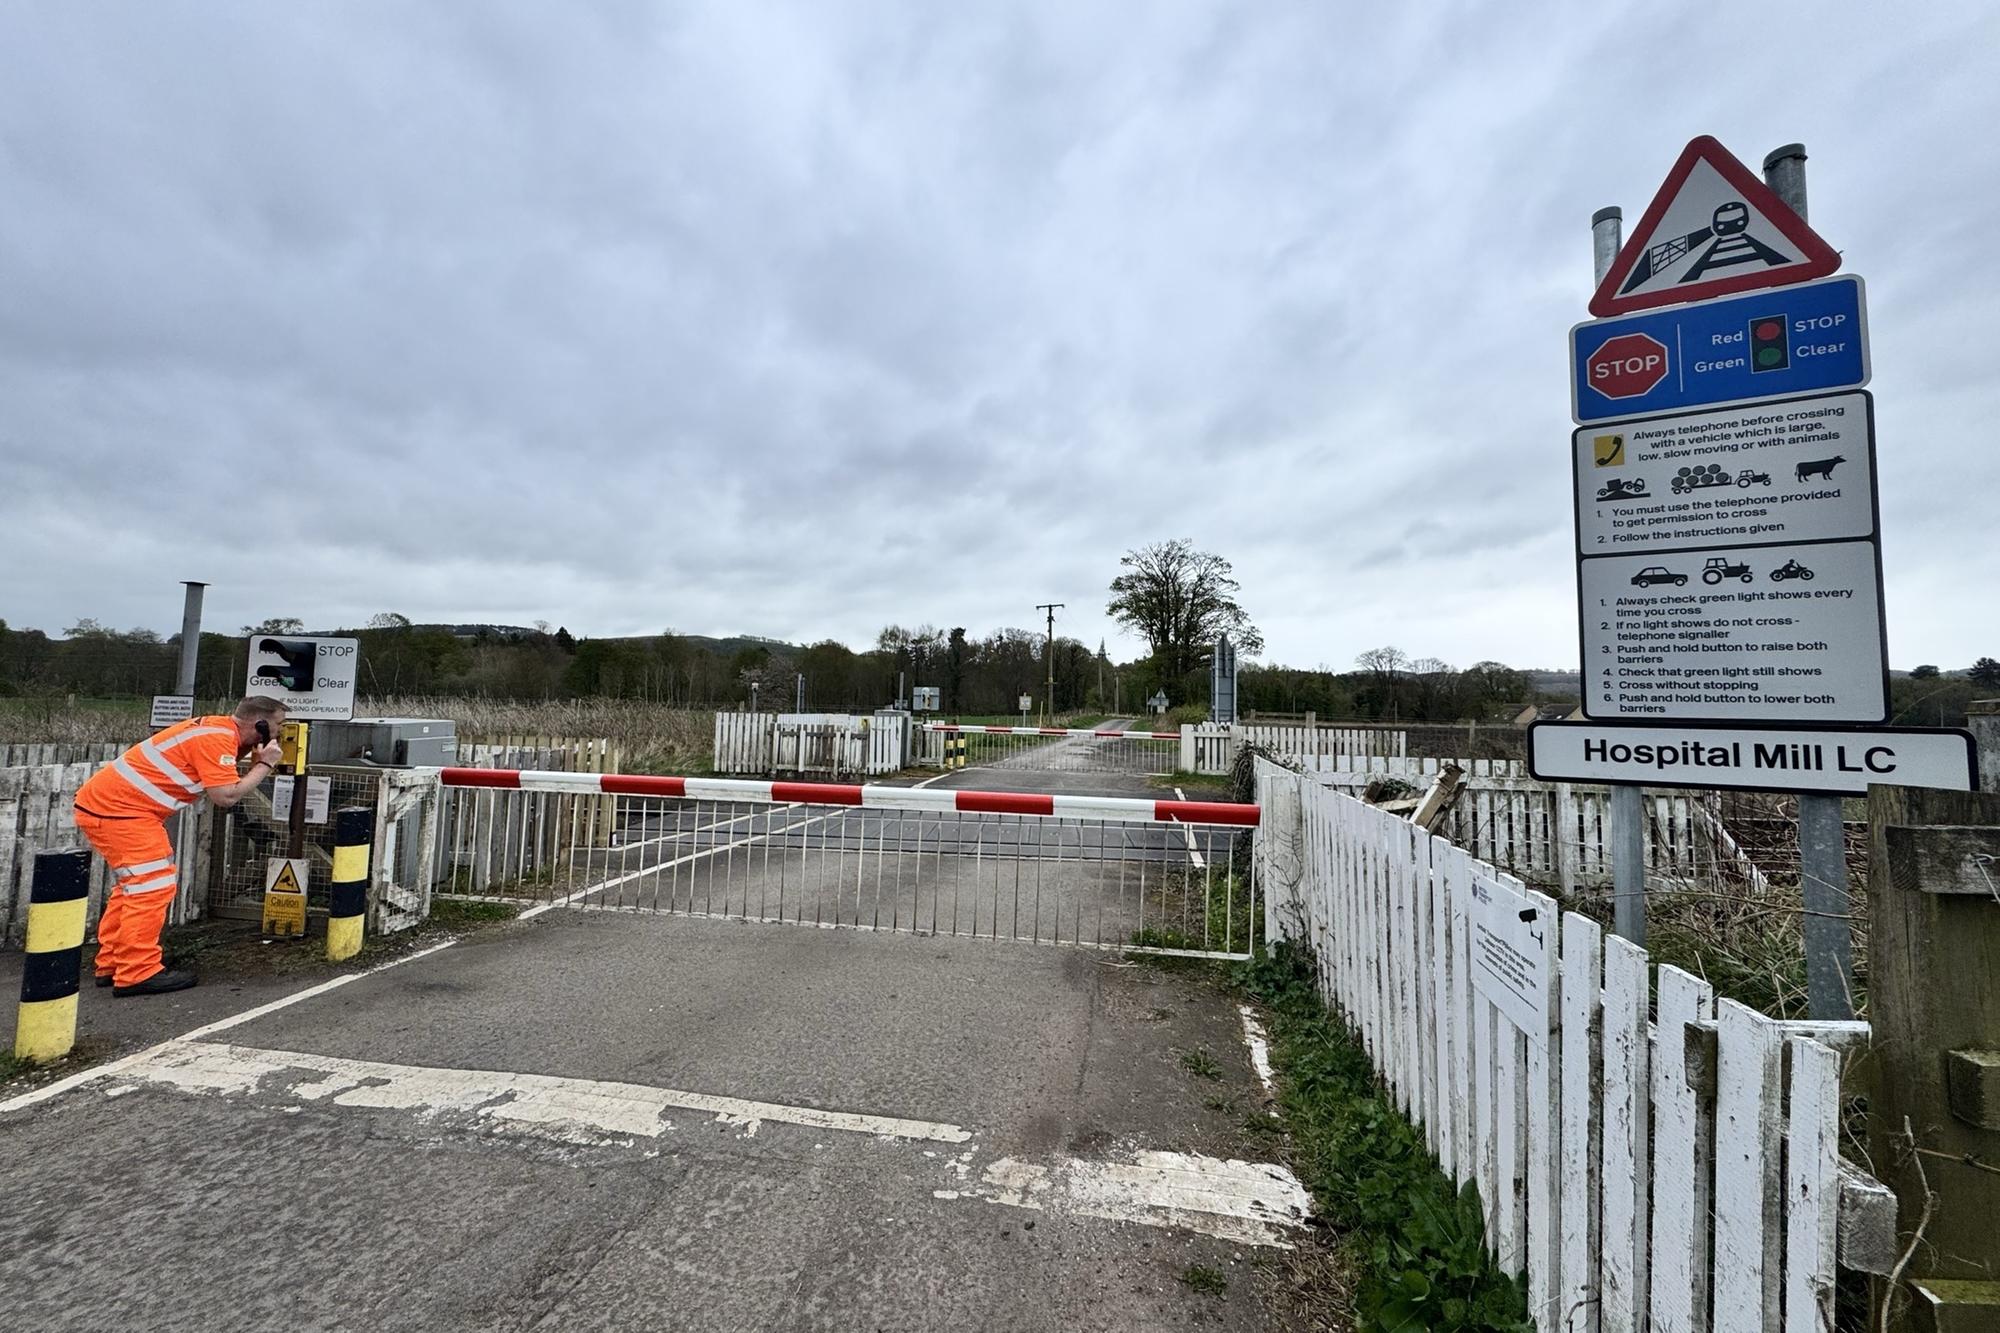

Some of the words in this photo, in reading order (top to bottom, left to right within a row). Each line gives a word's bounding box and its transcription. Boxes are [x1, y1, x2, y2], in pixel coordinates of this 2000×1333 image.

[1712, 330, 1743, 346] Red
[1794, 313, 1846, 332] STOP
[1694, 357, 1744, 373] Green
[1796, 341, 1846, 358] Clear
[1595, 354, 1660, 379] STOP
[1633, 428, 1676, 441] Always
[1678, 420, 1739, 435] telephone
[1741, 414, 1784, 427] before
[1786, 407, 1845, 421] crossing
[1650, 437, 1675, 449] with
[1688, 432, 1732, 445] vehicle
[1734, 427, 1772, 439] which
[1775, 425, 1786, 435] is
[1663, 449, 1691, 459] slow
[1693, 443, 1739, 456] moving
[1741, 441, 1755, 450] or
[1757, 437, 1785, 448] with
[1788, 431, 1840, 445] animals
[1612, 508, 1634, 516] You
[1636, 505, 1665, 515] must
[1668, 503, 1690, 512] use
[1692, 500, 1712, 510] the
[1714, 495, 1778, 508] telephone
[1780, 489, 1841, 504] provided
[1626, 517, 1645, 528] get
[1647, 512, 1714, 526] permission
[1716, 511, 1729, 519] to
[1731, 508, 1767, 518] cross
[1597, 535, 1607, 543] 2.
[1612, 533, 1650, 542] Follow
[1652, 531, 1671, 539] the
[1674, 525, 1747, 538] instructions
[1749, 523, 1785, 534] given
[1616, 597, 1658, 606] Always
[1660, 595, 1697, 604] check
[1699, 594, 1735, 604] green
[1738, 591, 1765, 602] light
[1768, 590, 1811, 599] shows
[1814, 589, 1853, 599] every
[1616, 609, 1641, 617] time
[1644, 609, 1665, 617] you
[1668, 607, 1702, 615] cross
[1600, 622, 1611, 630] 2.
[1616, 621, 1623, 629] If
[1643, 620, 1669, 630] light
[1671, 619, 1711, 628] shows
[1713, 618, 1729, 627] do
[1732, 618, 1753, 626] not
[1756, 617, 1793, 626] cross
[1617, 631, 1676, 641] telephone
[1678, 630, 1730, 640] signaller
[318, 645, 354, 657] STOP
[1601, 645, 1612, 654] 3.
[1617, 645, 1645, 653] Push
[1648, 644, 1671, 653] and
[1673, 644, 1699, 652] hold
[1701, 643, 1743, 652] button
[1745, 643, 1759, 651] to
[1761, 642, 1793, 651] raise
[1797, 641, 1828, 651] both
[1617, 655, 1664, 664] barriers
[1602, 668, 1613, 676] 4.
[1618, 668, 1655, 677] Check
[1657, 667, 1682, 676] that
[1684, 668, 1720, 678] green
[1722, 667, 1750, 678] light
[1752, 667, 1775, 676] still
[1777, 667, 1822, 676] shows
[249, 675, 283, 687] Gree
[317, 677, 349, 688] Clear
[1603, 681, 1613, 689] 5.
[1619, 681, 1653, 689] Cross
[1655, 681, 1701, 689] without
[1703, 681, 1759, 691] stopping
[1603, 693, 1614, 702] 6.
[1619, 693, 1648, 702] Push
[1650, 694, 1673, 702] and
[1675, 694, 1702, 703] hold
[1704, 694, 1745, 703] button
[1748, 695, 1762, 703] to
[1764, 694, 1801, 704] lower
[1804, 695, 1835, 704] both
[1620, 704, 1666, 713] barriers
[1584, 738, 1741, 769] Hospital
[1753, 743, 1823, 771] Mill
[1837, 746, 1897, 773] LC
[270, 896, 299, 908] Caution
